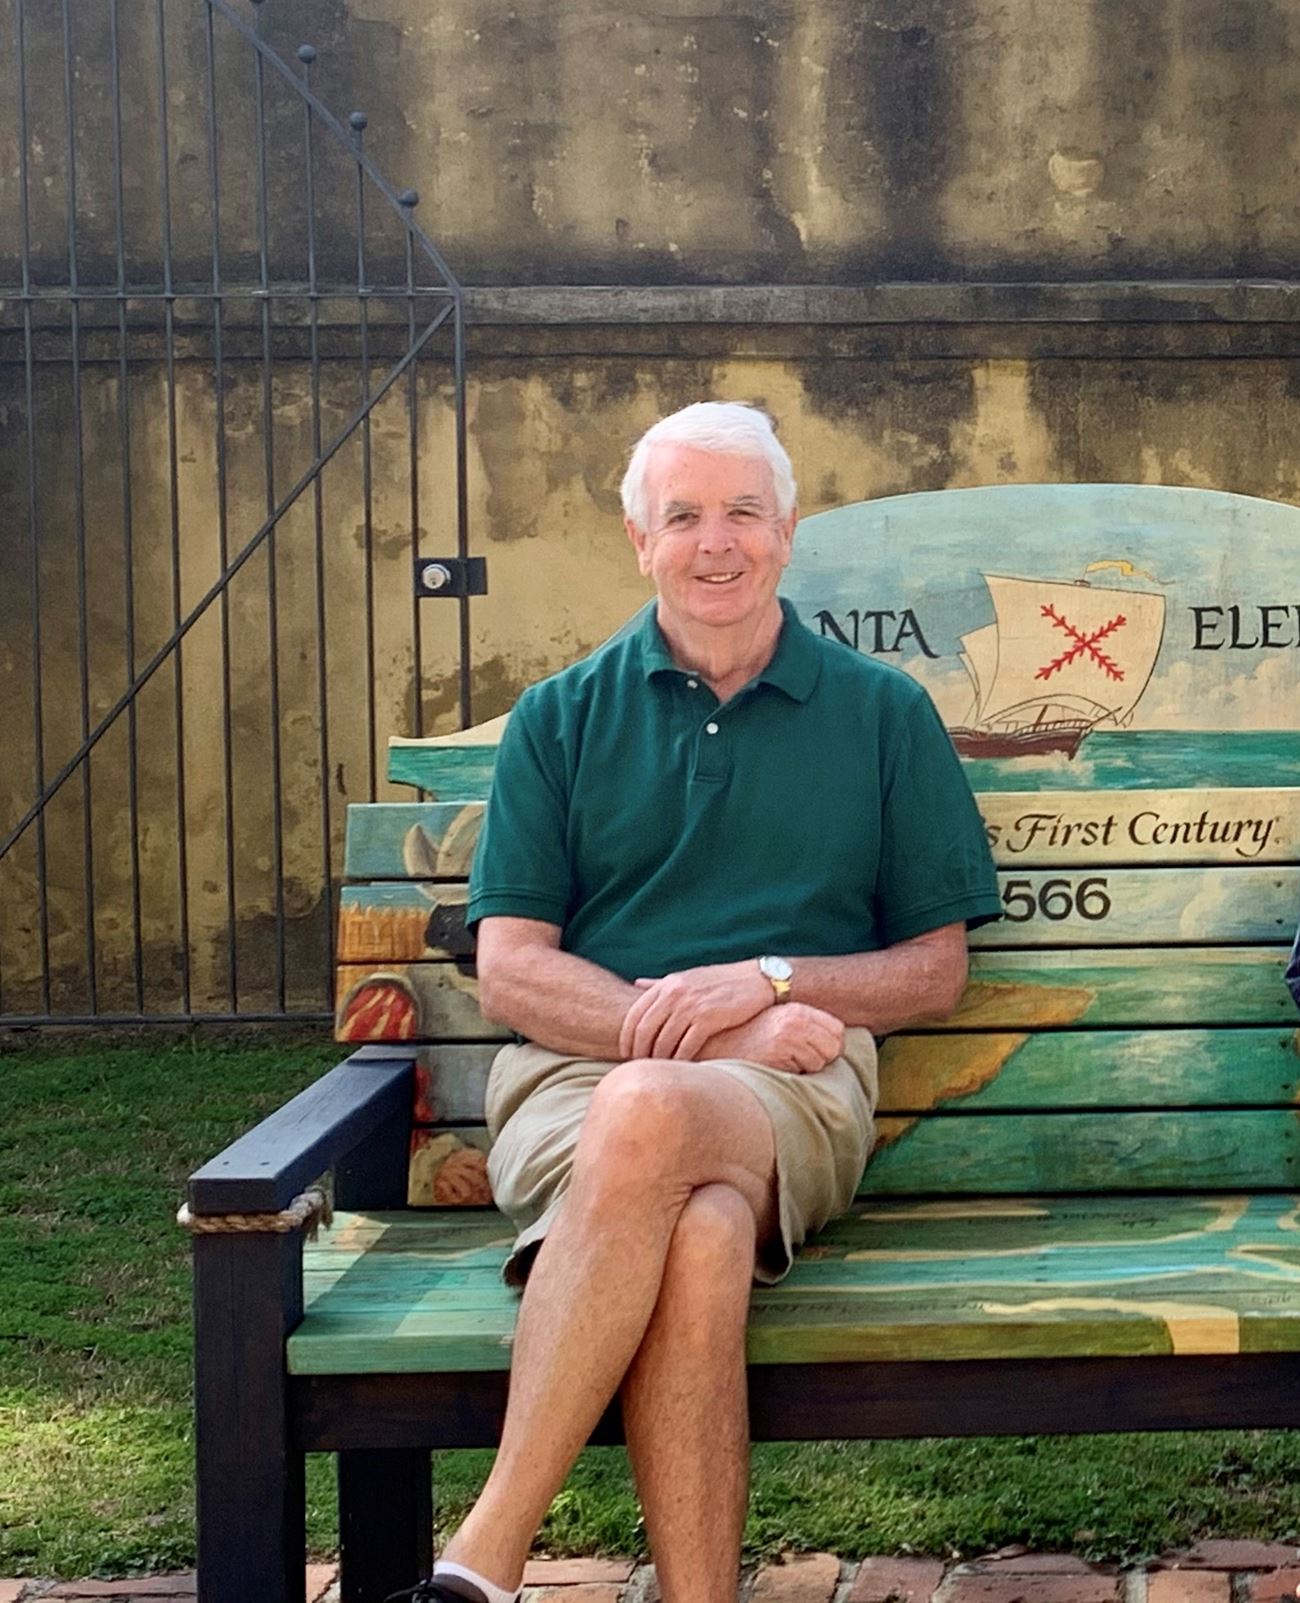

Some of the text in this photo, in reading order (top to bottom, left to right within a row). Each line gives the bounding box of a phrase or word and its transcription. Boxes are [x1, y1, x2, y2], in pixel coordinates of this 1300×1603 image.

[812, 608, 941, 659] NTA
[985, 810, 1274, 858] s First Century
[1001, 877, 1111, 922] 566
